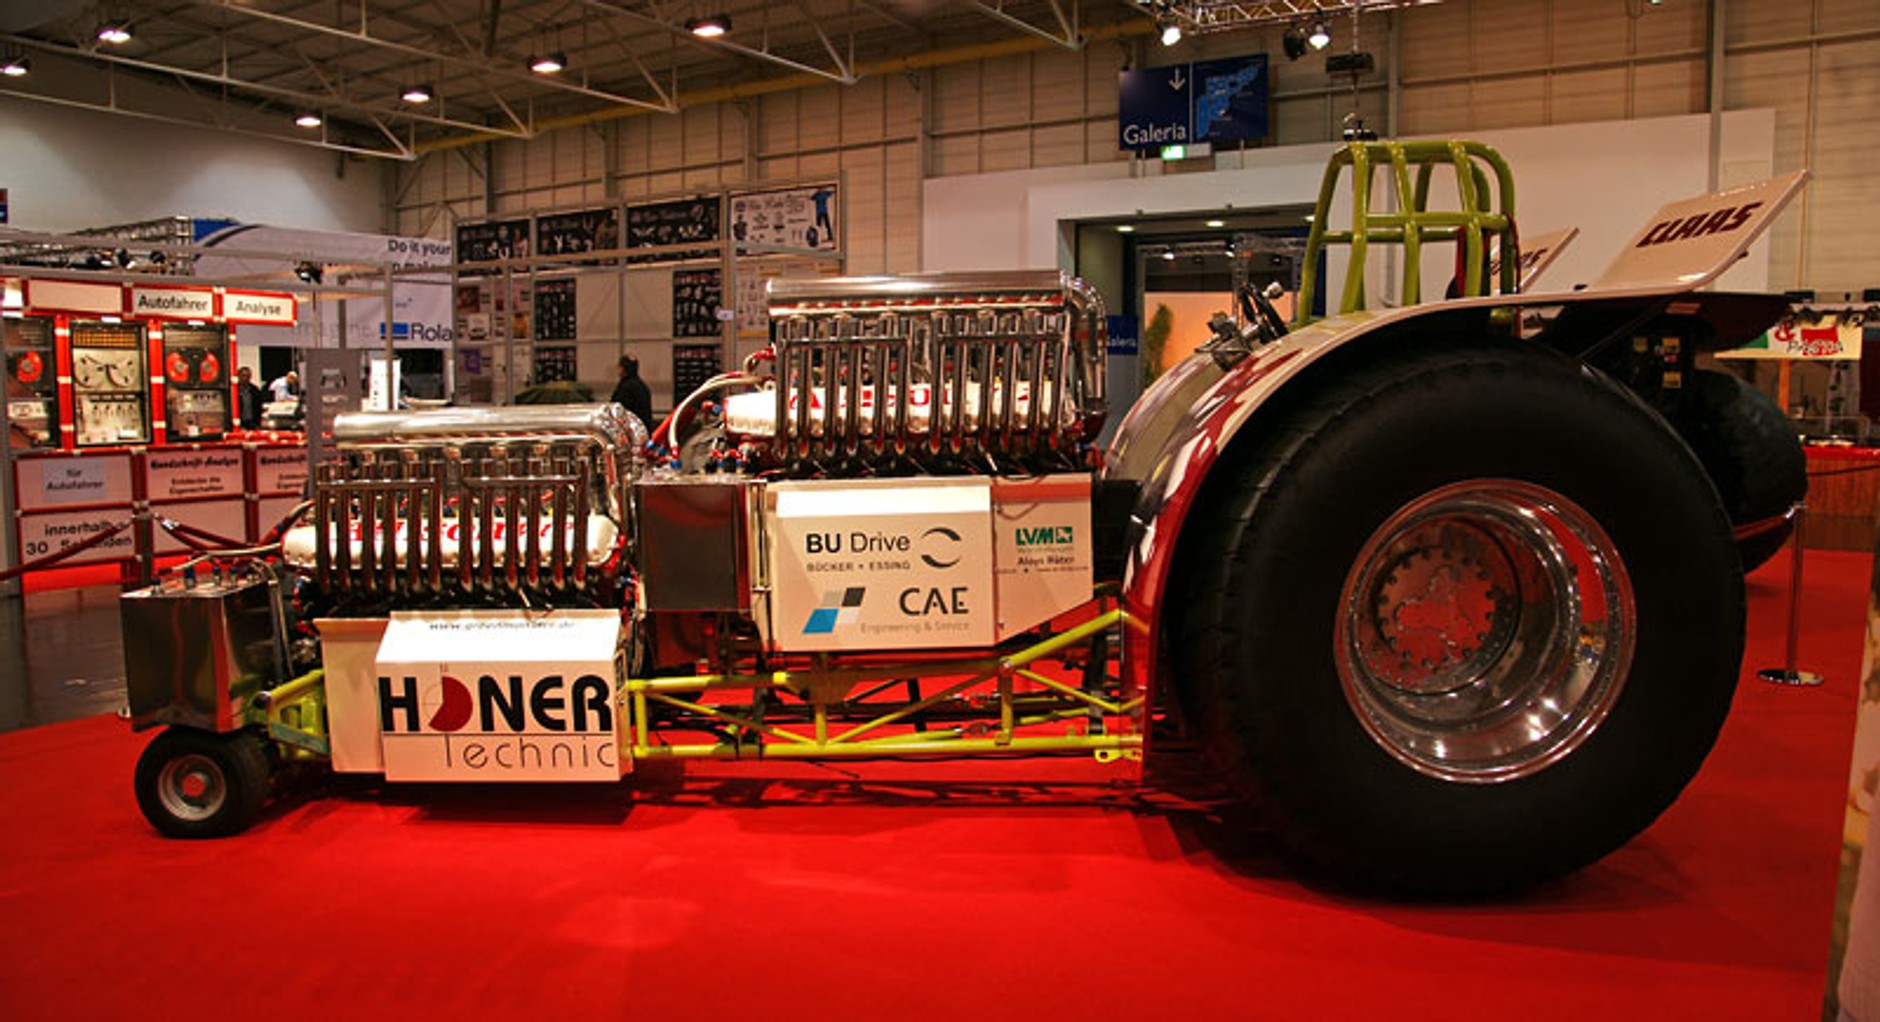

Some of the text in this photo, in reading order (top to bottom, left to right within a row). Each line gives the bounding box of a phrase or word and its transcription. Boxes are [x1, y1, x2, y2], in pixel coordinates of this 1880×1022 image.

[1123, 123, 1186, 145] Galeria
[1636, 201, 1764, 248] CLAAS
[388, 239, 408, 252] Do
[138, 294, 208, 311] Autofahrer
[235, 301, 281, 315] Analyse
[46, 480, 103, 491] Autofahrer
[806, 531, 911, 554] BU Drive
[1016, 527, 1055, 546] LVM
[26, 541, 48, 556] 30
[868, 560, 910, 571] ESSING
[899, 586, 969, 616] CAE
[861, 622, 921, 634] Engineering
